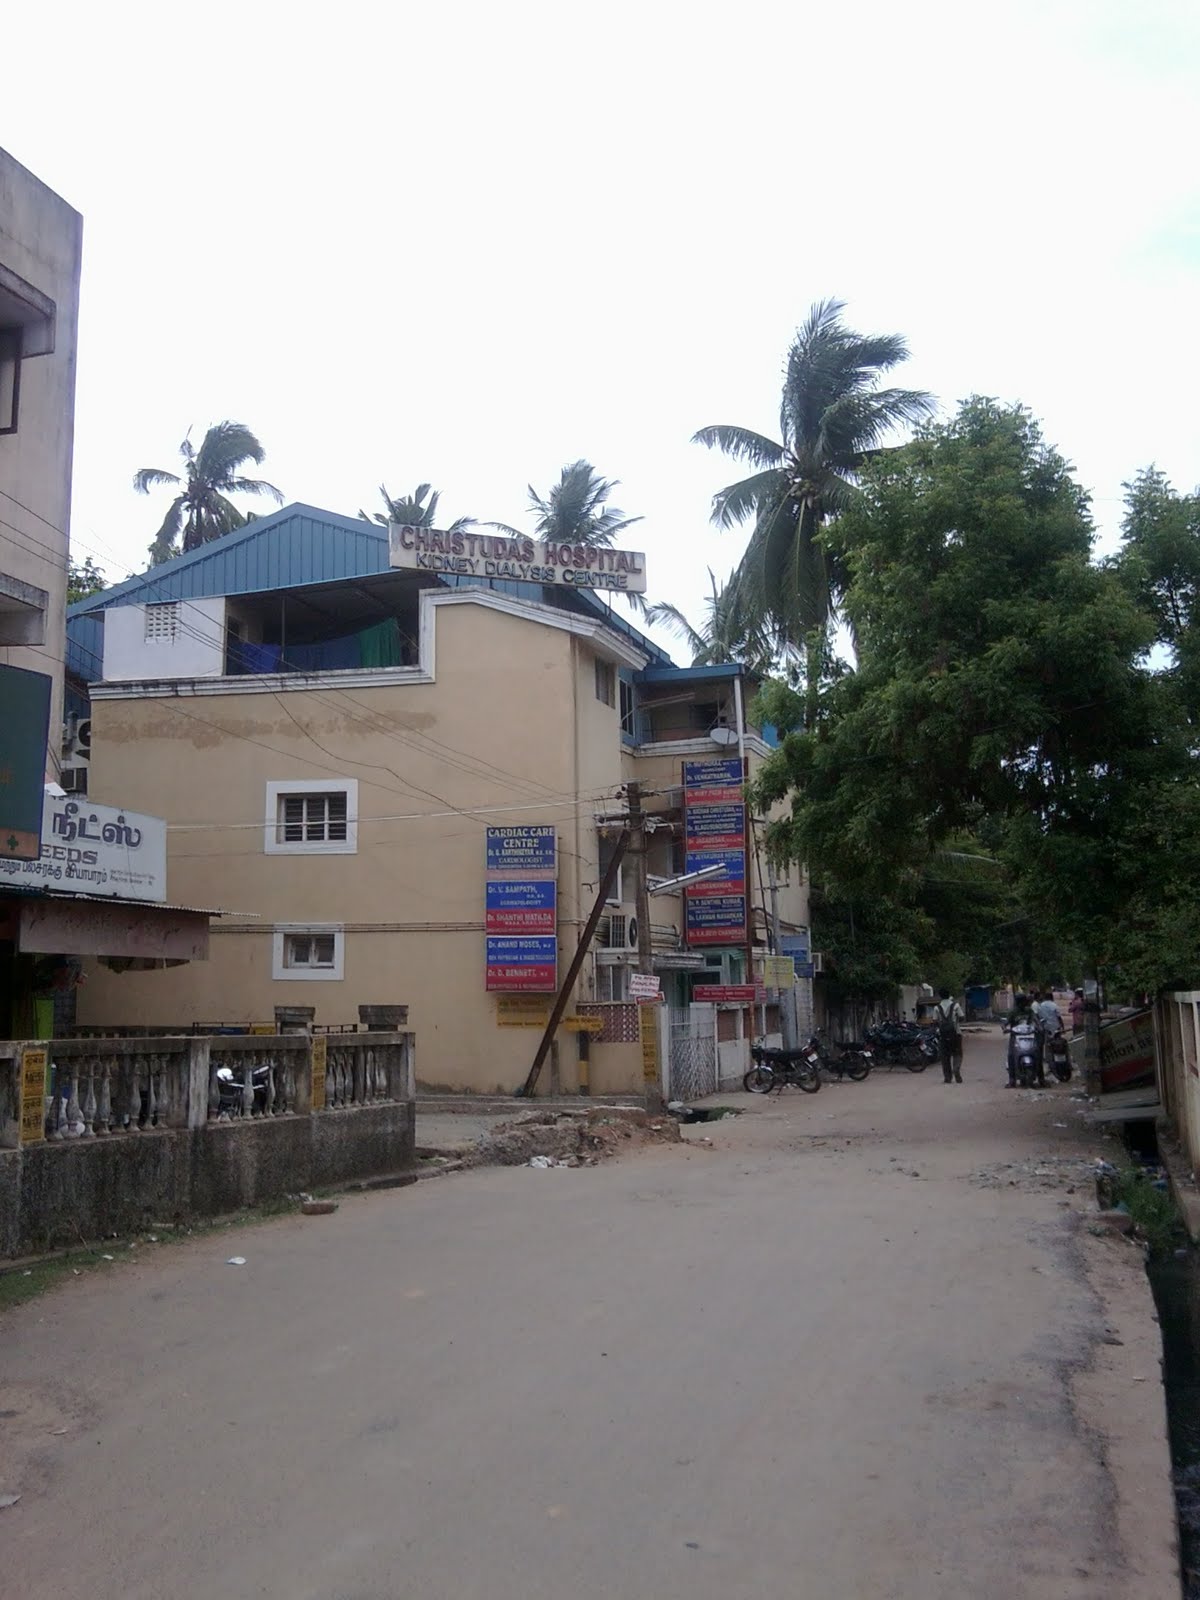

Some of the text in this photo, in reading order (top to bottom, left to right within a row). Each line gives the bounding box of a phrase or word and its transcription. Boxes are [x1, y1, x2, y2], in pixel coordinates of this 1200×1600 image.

[399, 525, 643, 574] CHRISTUDAS HOSPITAL
[415, 552, 629, 589] KIDNEY DIALYSIS CENTRE
[52, 802, 142, 848] நீட்ஸ்
[487, 827, 554, 838] CARDIAC CARE
[41, 843, 98, 866] EEDS
[503, 838, 540, 848] CENTRE
